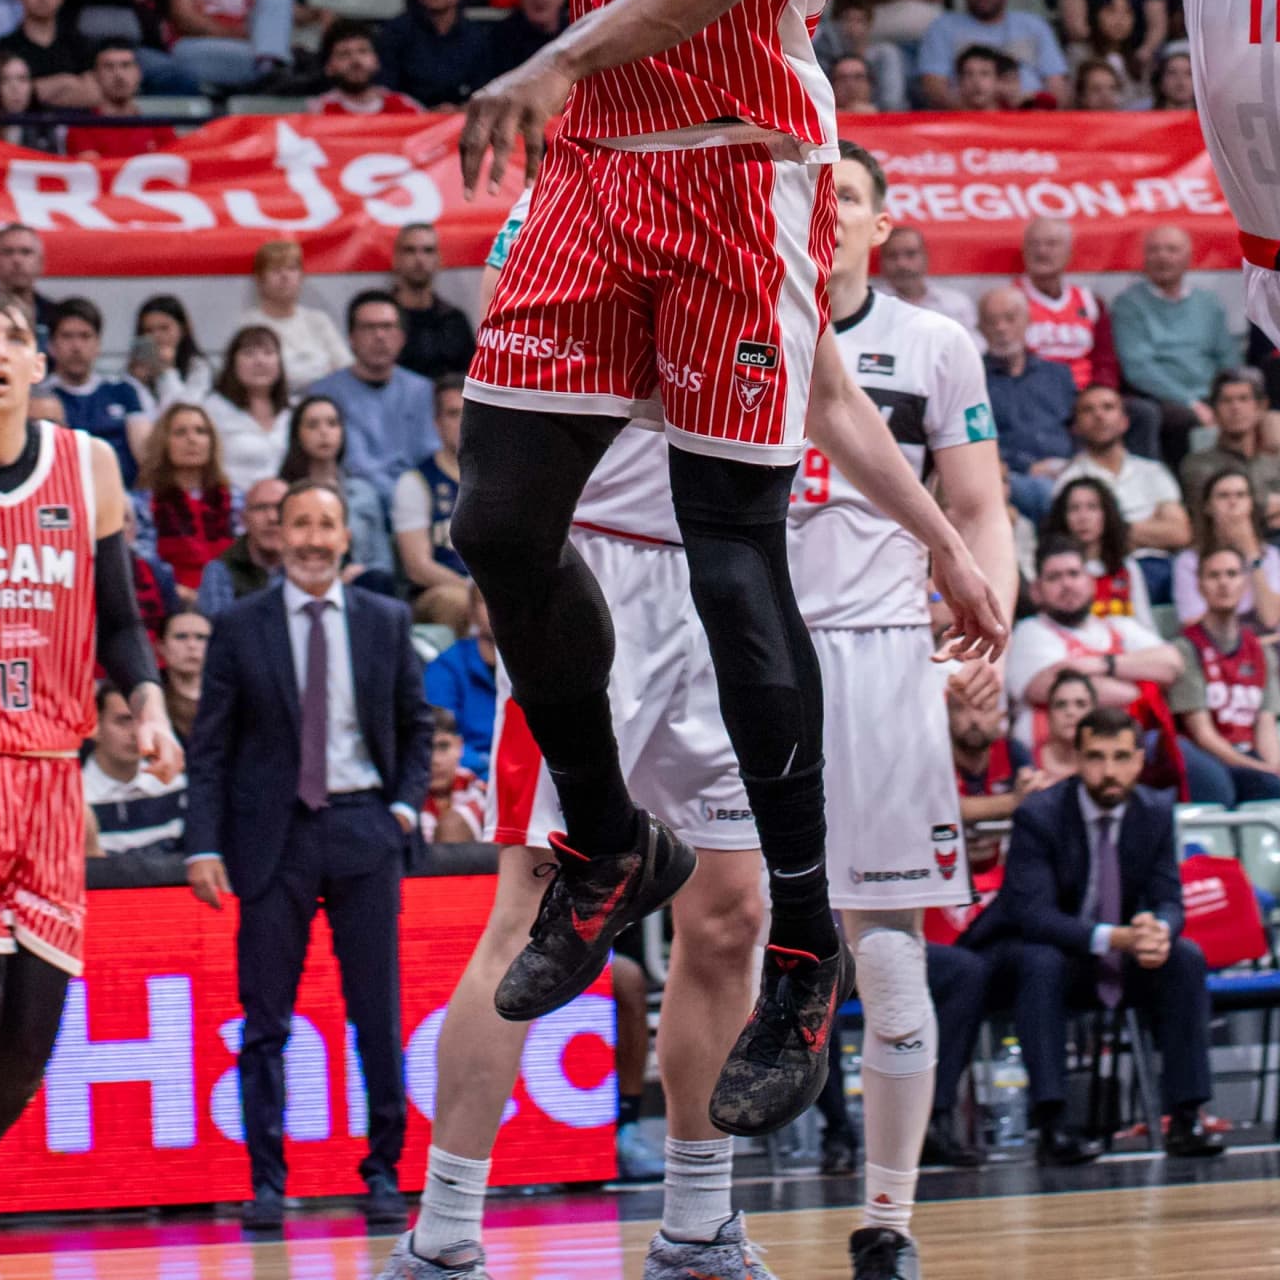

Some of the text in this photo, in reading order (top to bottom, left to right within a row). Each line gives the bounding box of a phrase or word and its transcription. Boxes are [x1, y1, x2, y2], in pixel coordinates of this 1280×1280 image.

[885, 175, 1228, 222] REGIÓN DE
[739, 349, 768, 365] acb
[788, 448, 831, 505] 9
